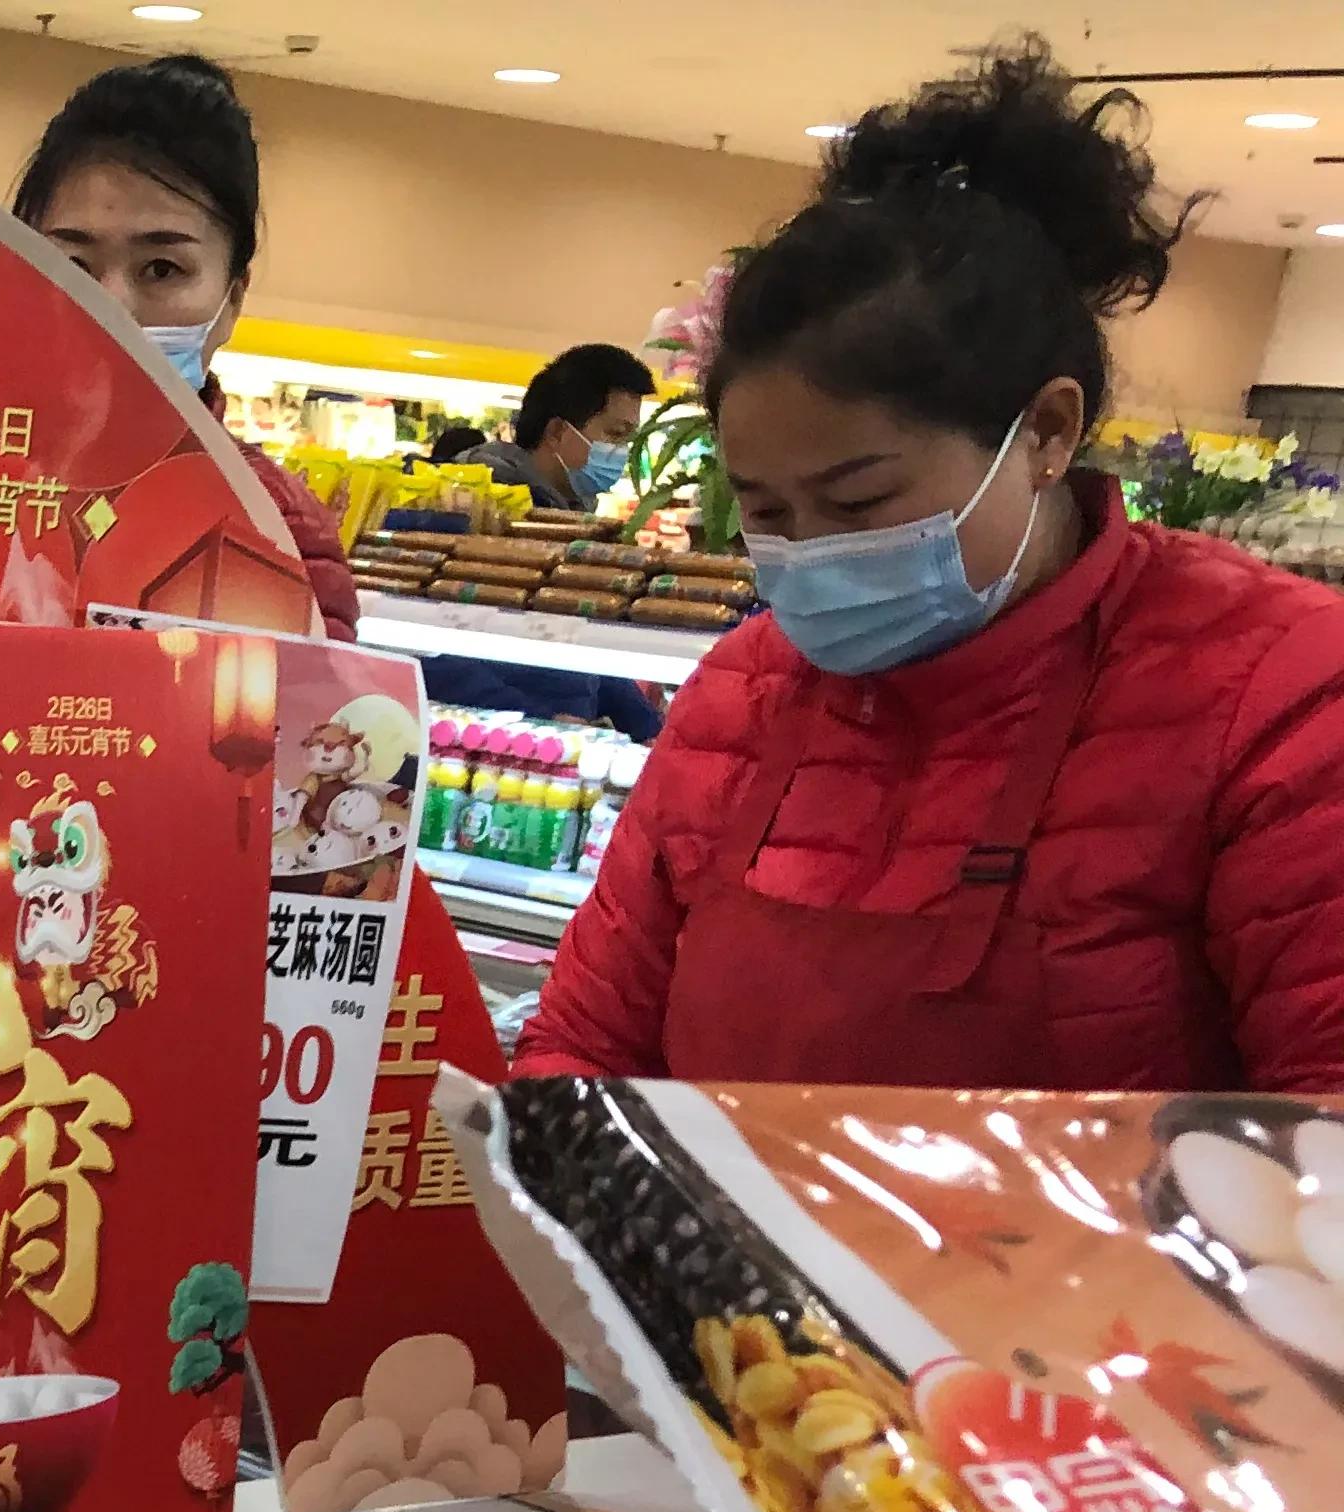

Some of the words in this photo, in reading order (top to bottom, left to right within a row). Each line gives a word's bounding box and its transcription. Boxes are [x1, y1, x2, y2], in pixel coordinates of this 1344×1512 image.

[47, 696, 113, 722] 2月26日
[27, 725, 132, 758] 喜乐元宵节
